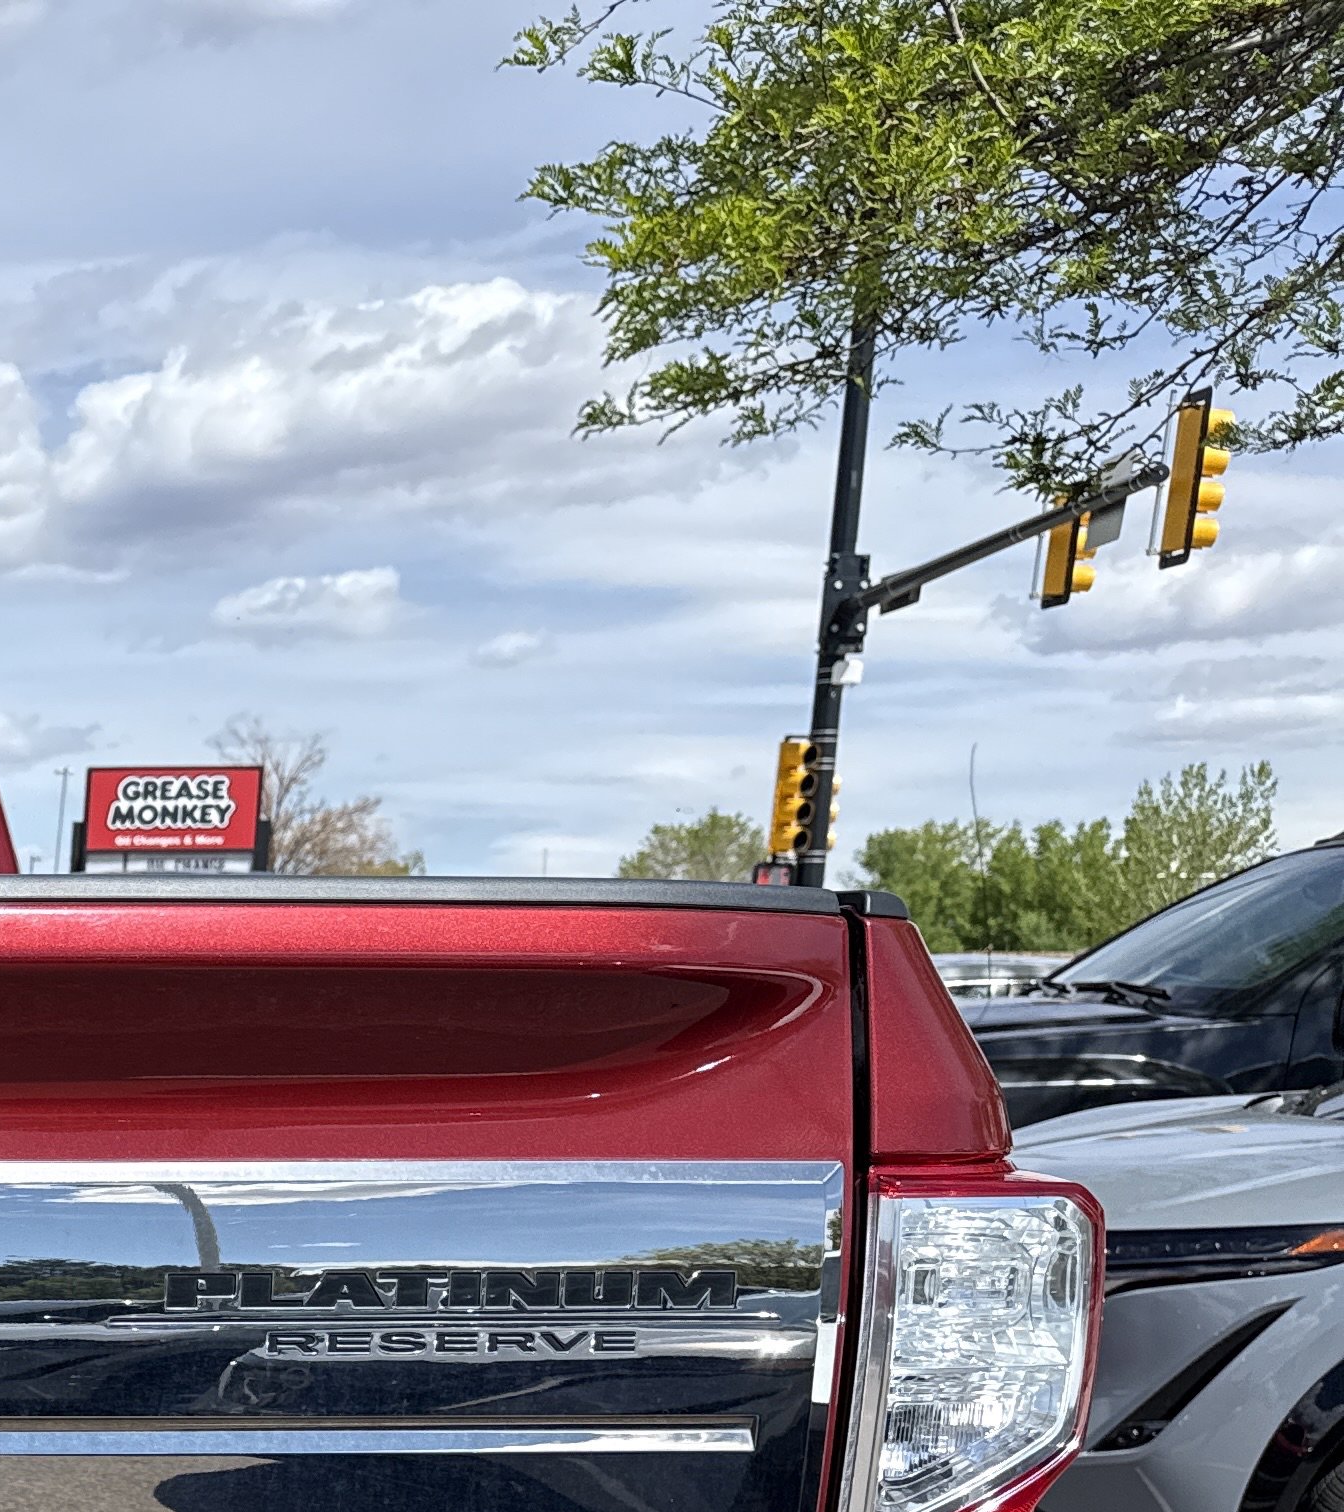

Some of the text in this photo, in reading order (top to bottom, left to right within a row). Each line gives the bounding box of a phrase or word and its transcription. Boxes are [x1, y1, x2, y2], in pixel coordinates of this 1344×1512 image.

[121, 779, 226, 801] GREASE
[111, 803, 232, 826] MONKEY
[164, 1269, 739, 1312] PLATINUM
[265, 1330, 637, 1357] RESERVE
